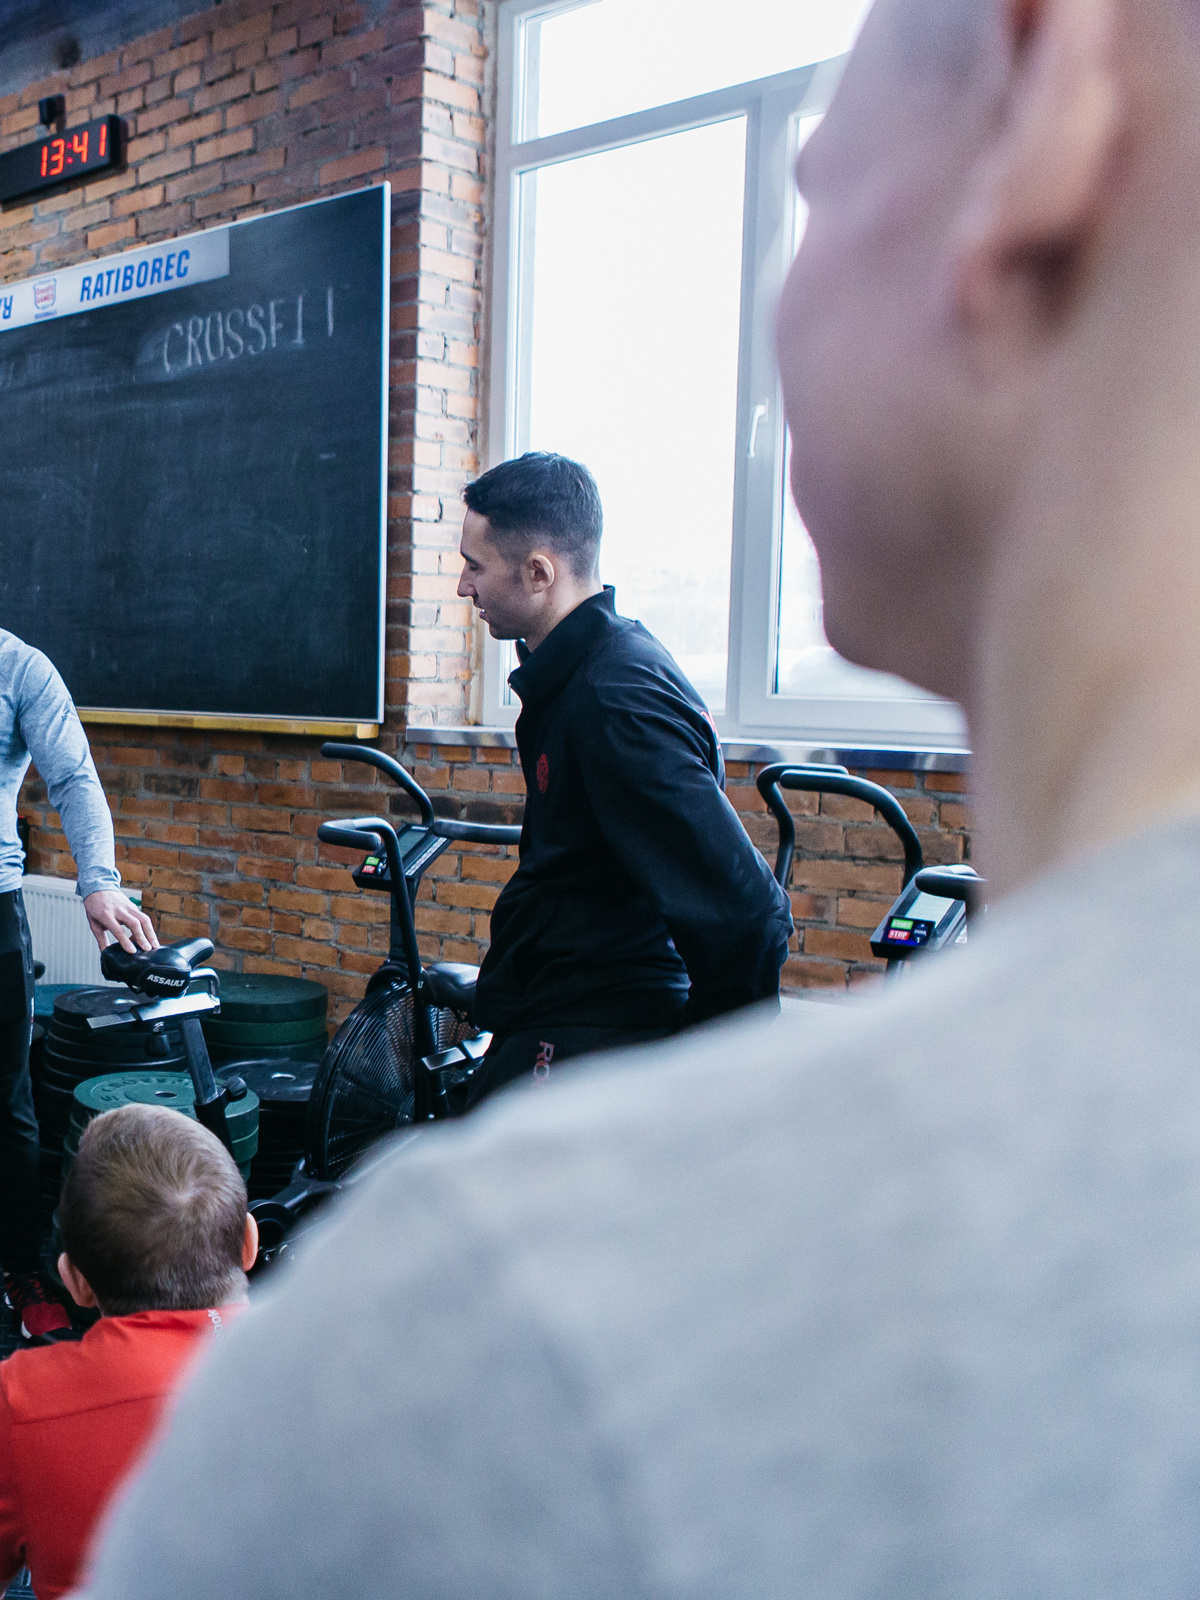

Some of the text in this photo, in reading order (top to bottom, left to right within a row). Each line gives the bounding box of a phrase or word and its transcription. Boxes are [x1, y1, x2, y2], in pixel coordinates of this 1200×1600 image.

[40, 123, 107, 177] 13:41
[80, 249, 191, 303] RATIBOREC
[146, 974, 186, 987] ASSAULT
